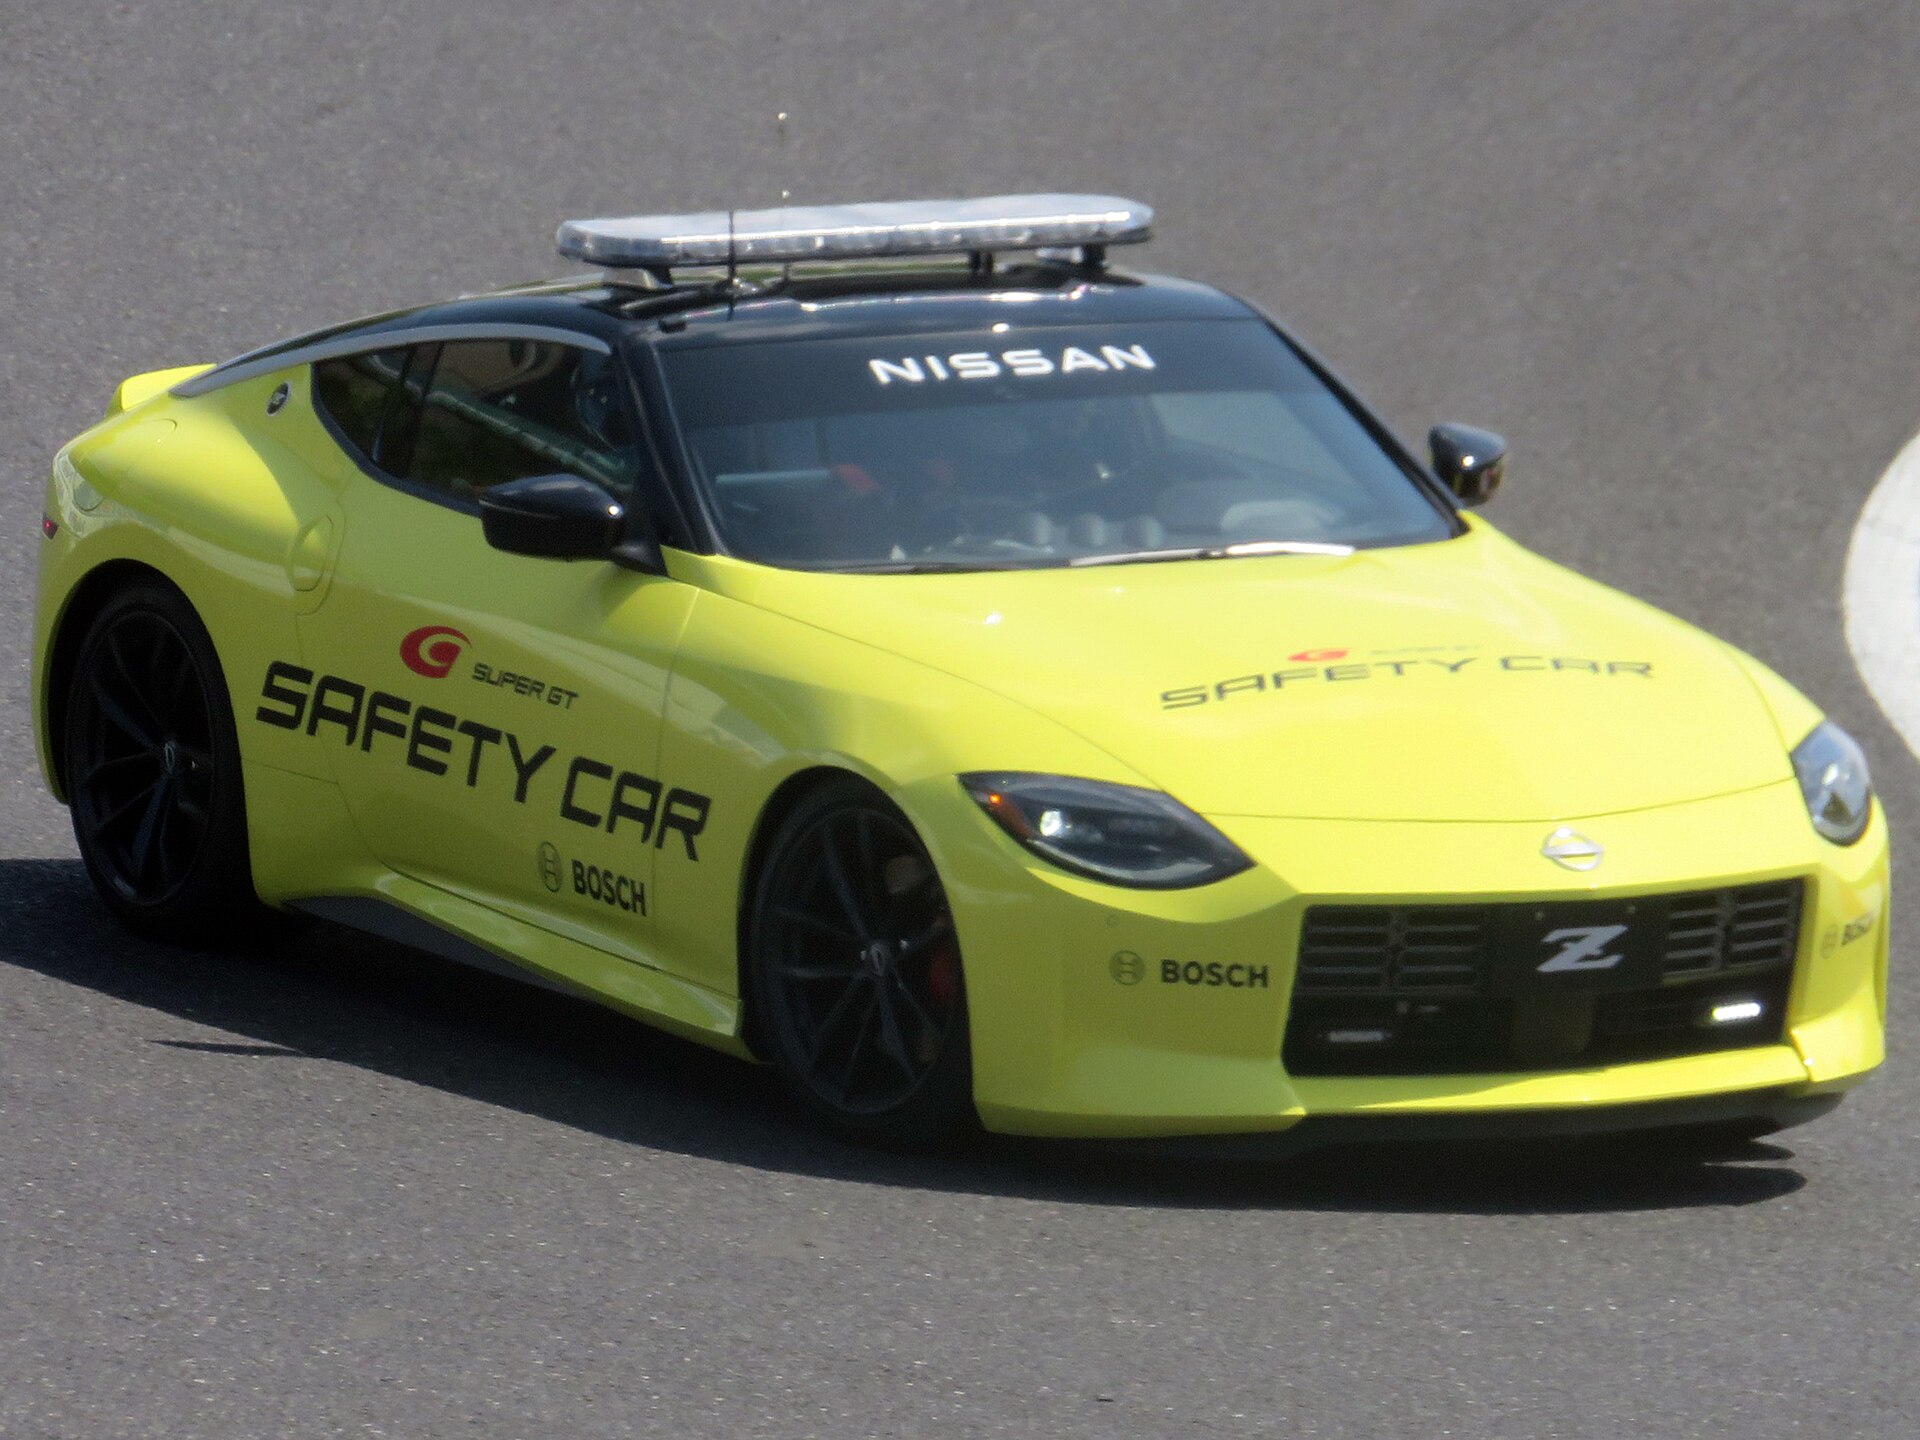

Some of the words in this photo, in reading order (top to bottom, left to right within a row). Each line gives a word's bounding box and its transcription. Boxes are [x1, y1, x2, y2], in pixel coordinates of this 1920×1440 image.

[868, 345, 1156, 385] NISSAN
[472, 662, 546, 700] SUPER
[547, 686, 579, 710] GT
[1161, 657, 1478, 711] SAFETY
[1499, 655, 1654, 678] CAR
[256, 660, 556, 803] SAFETY
[560, 755, 712, 862] CAR
[571, 859, 647, 917] BOSCH
[1160, 958, 1270, 989] BOSCH
